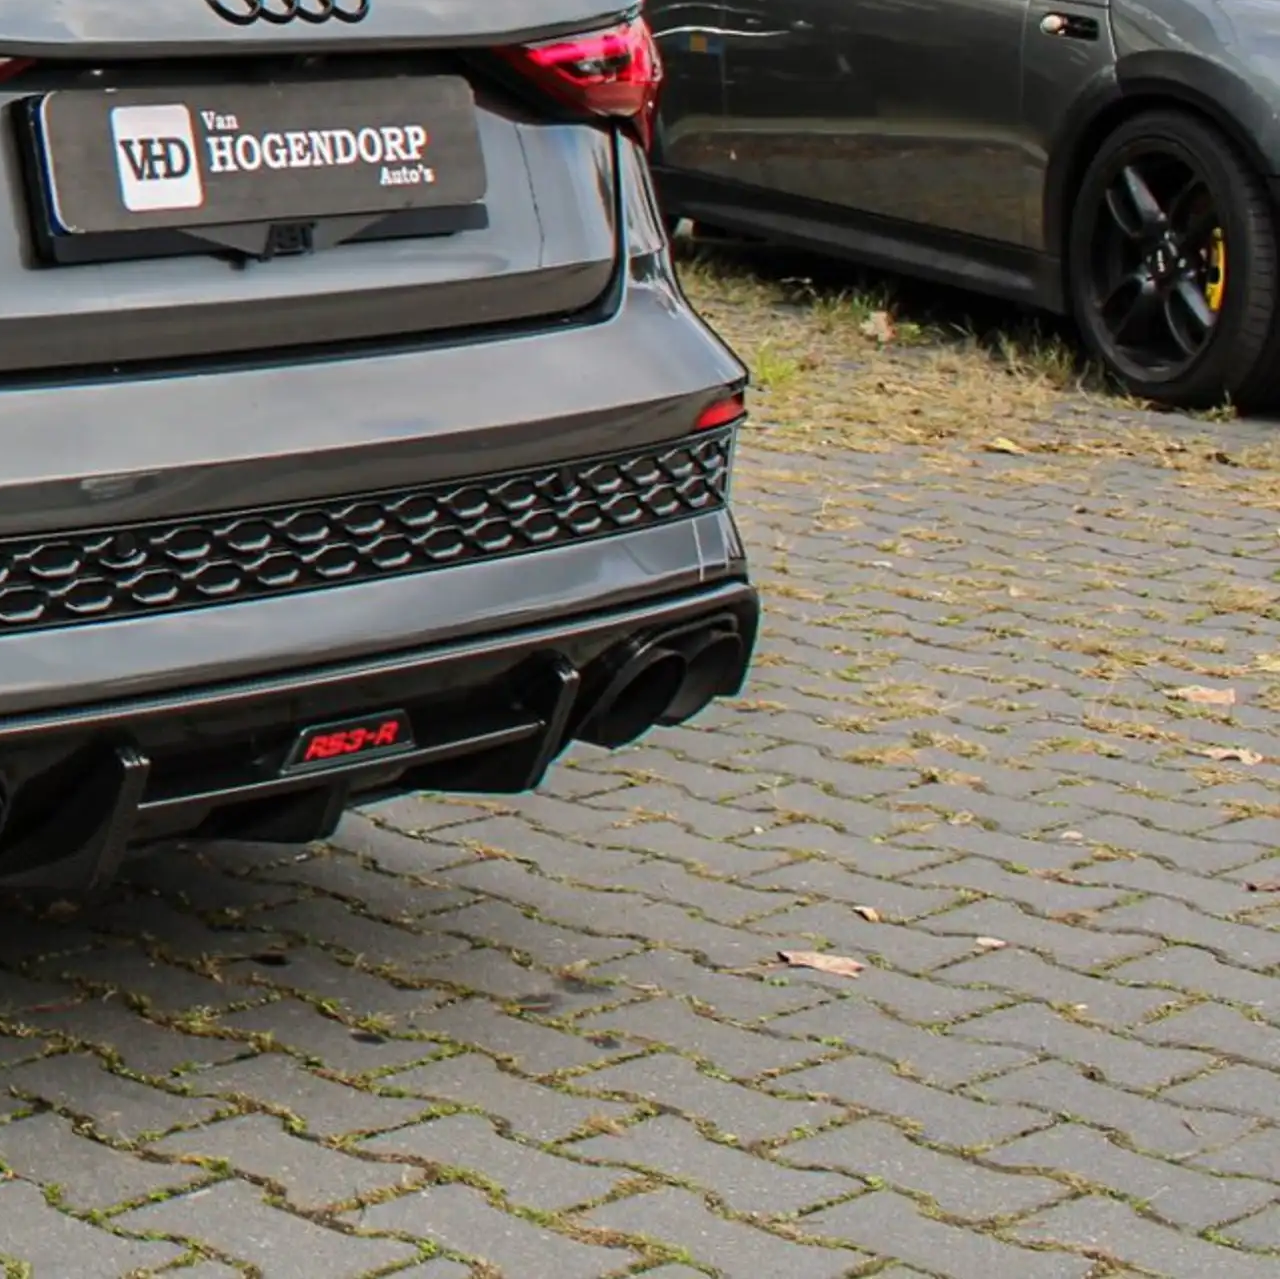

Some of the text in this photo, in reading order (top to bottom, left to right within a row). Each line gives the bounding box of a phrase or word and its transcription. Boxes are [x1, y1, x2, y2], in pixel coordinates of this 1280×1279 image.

[200, 110, 238, 131] Van
[118, 136, 193, 182] VHD
[206, 125, 429, 172] HOGENDORP
[380, 166, 434, 186] Auto's
[303, 721, 399, 761] RS3-R
